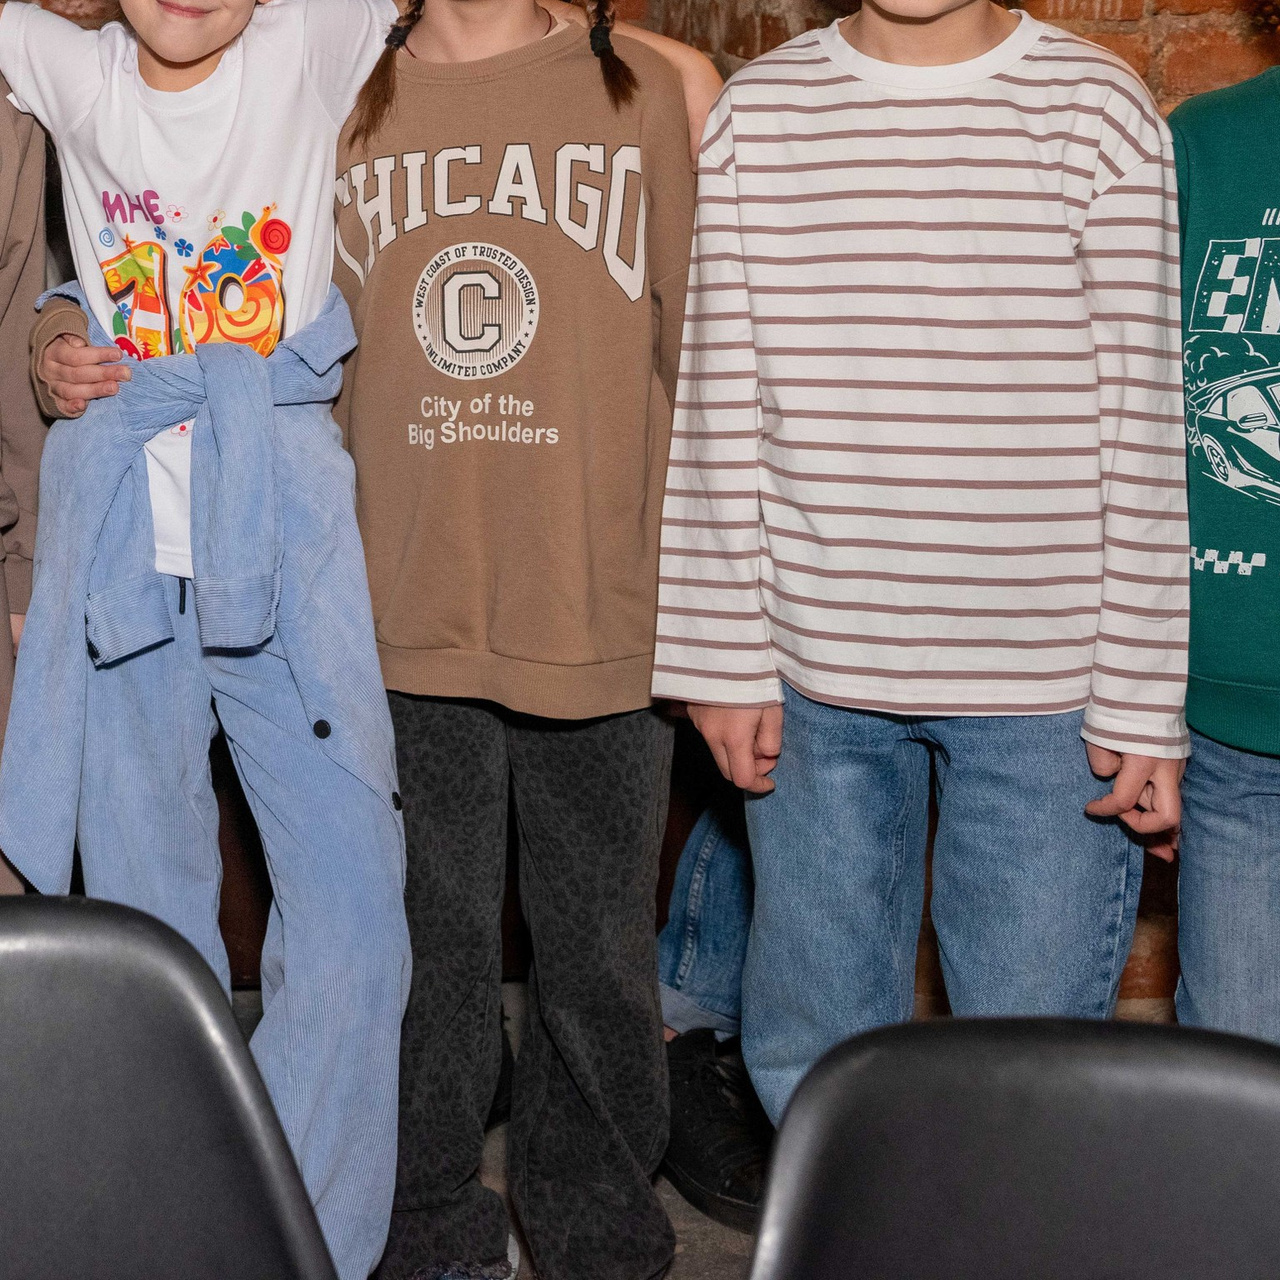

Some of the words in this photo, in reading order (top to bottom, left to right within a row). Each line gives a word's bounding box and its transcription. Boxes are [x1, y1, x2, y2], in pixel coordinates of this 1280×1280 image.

[102, 189, 165, 225] МНЕ
[415, 278, 429, 308] WEST
[426, 251, 452, 279] COAST
[454, 246, 468, 258] OF
[472, 245, 518, 271] TRUSTED
[514, 268, 536, 306] DESIGN
[100, 234, 285, 360] 10
[442, 270, 501, 353] C
[425, 342, 477, 377] UNLIMITED
[480, 340, 526, 375] COMPANY
[420, 395, 462, 422] City
[469, 393, 493, 414] of
[498, 394, 534, 417] the
[408, 423, 435, 450] Big
[440, 420, 559, 445] Shoulders
